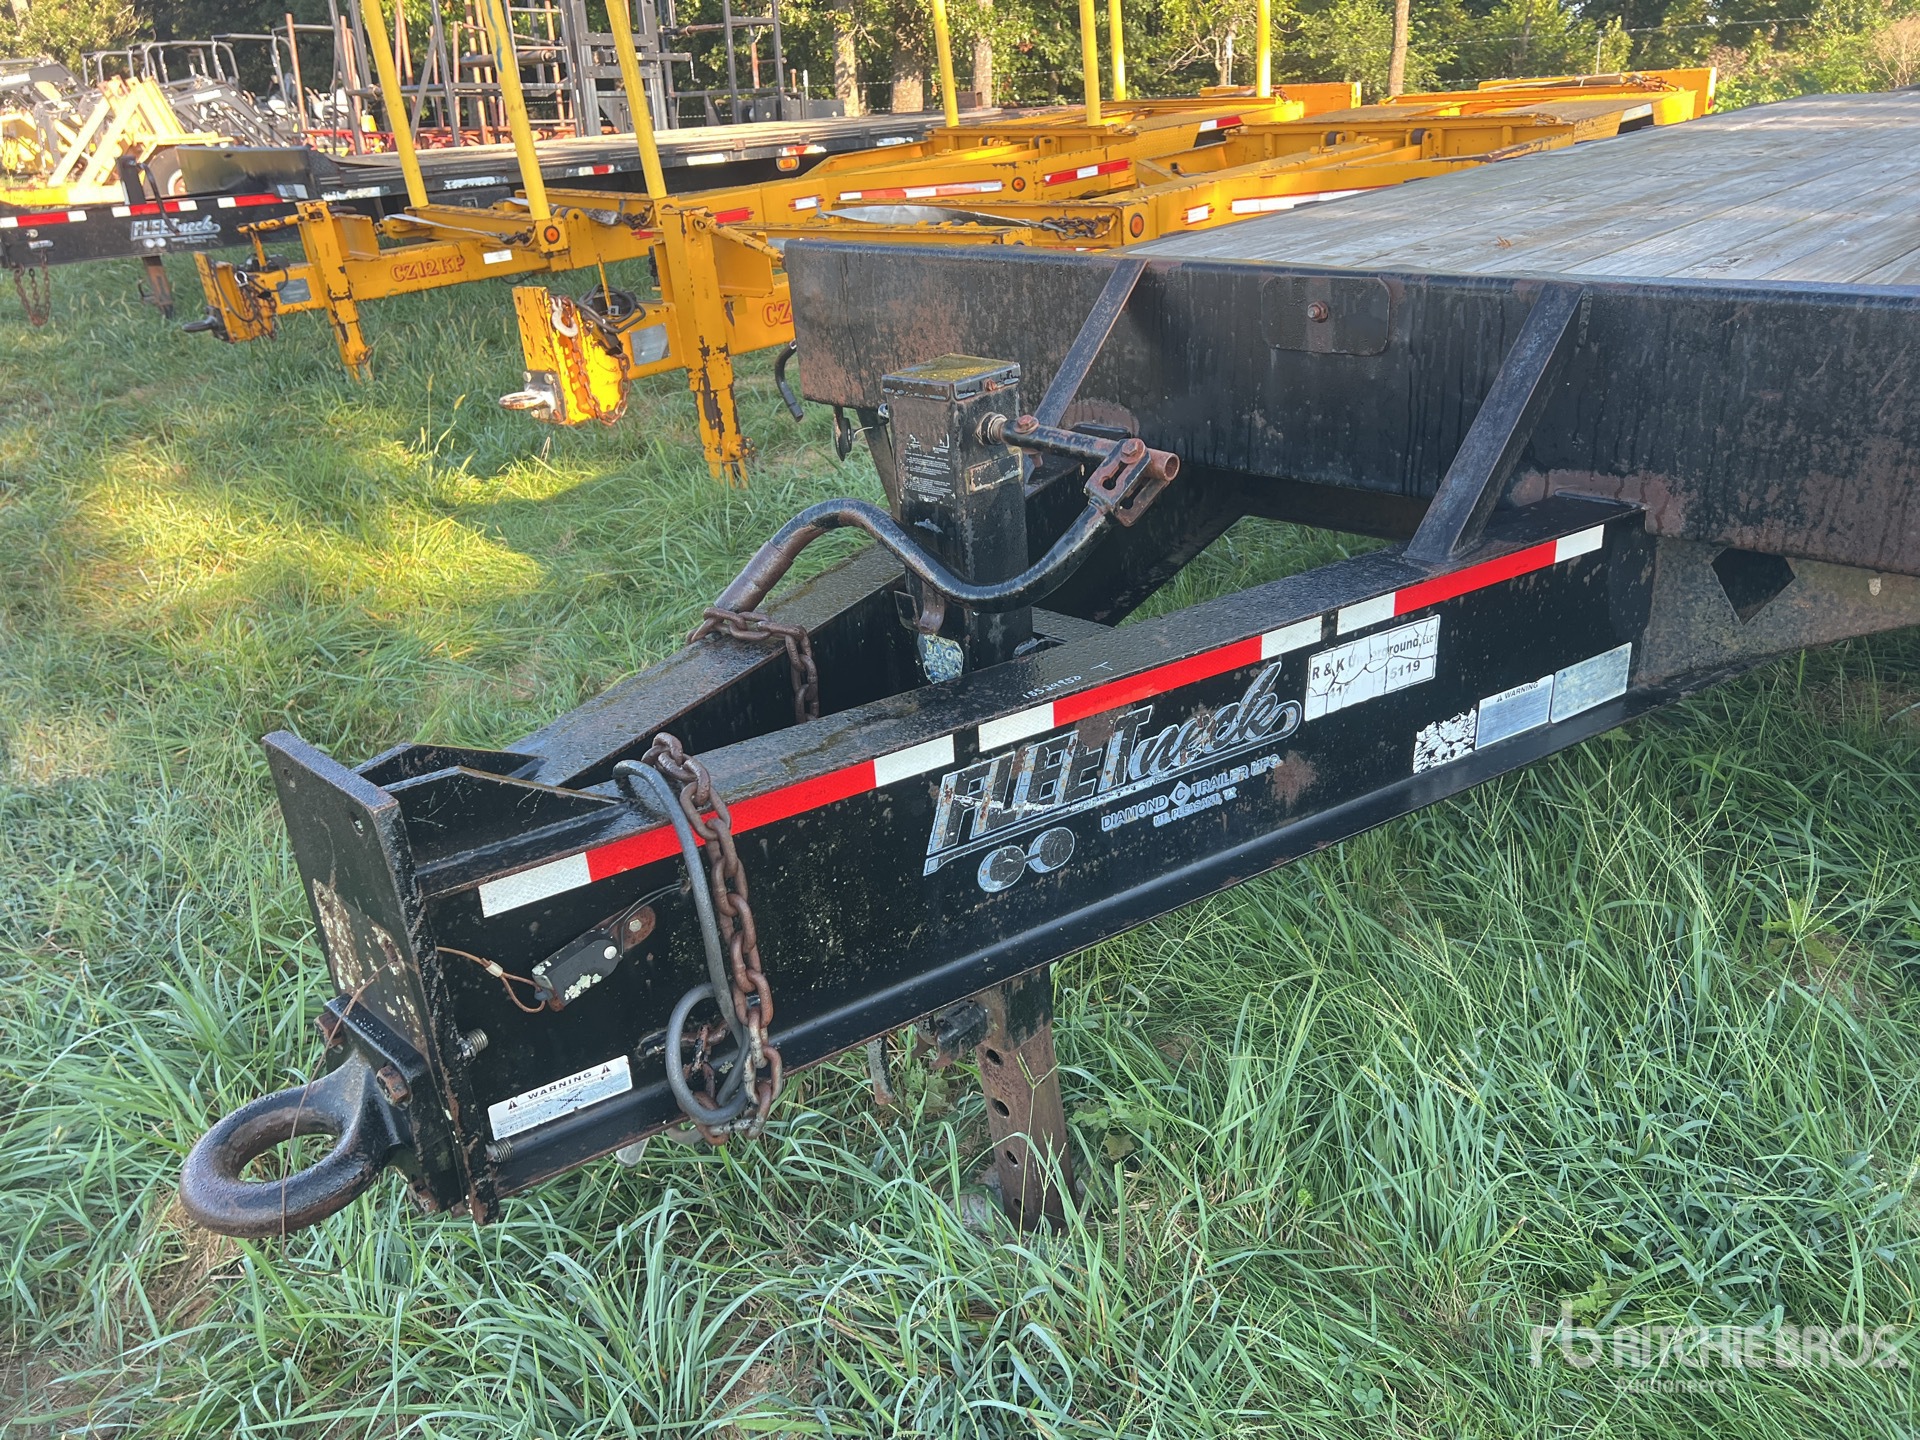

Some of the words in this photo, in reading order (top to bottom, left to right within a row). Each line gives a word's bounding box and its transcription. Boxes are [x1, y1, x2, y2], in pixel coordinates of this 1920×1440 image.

[390, 255, 466, 282] CZ12KP
[1312, 666, 1320, 680] R
[1323, 662, 1332, 676] &
[1336, 657, 1345, 671] K
[1504, 681, 1539, 699] WARNING
[1102, 795, 1169, 832] DIAMOND
[1191, 764, 1250, 797] TRAILER
[528, 1071, 593, 1100] WARNING
